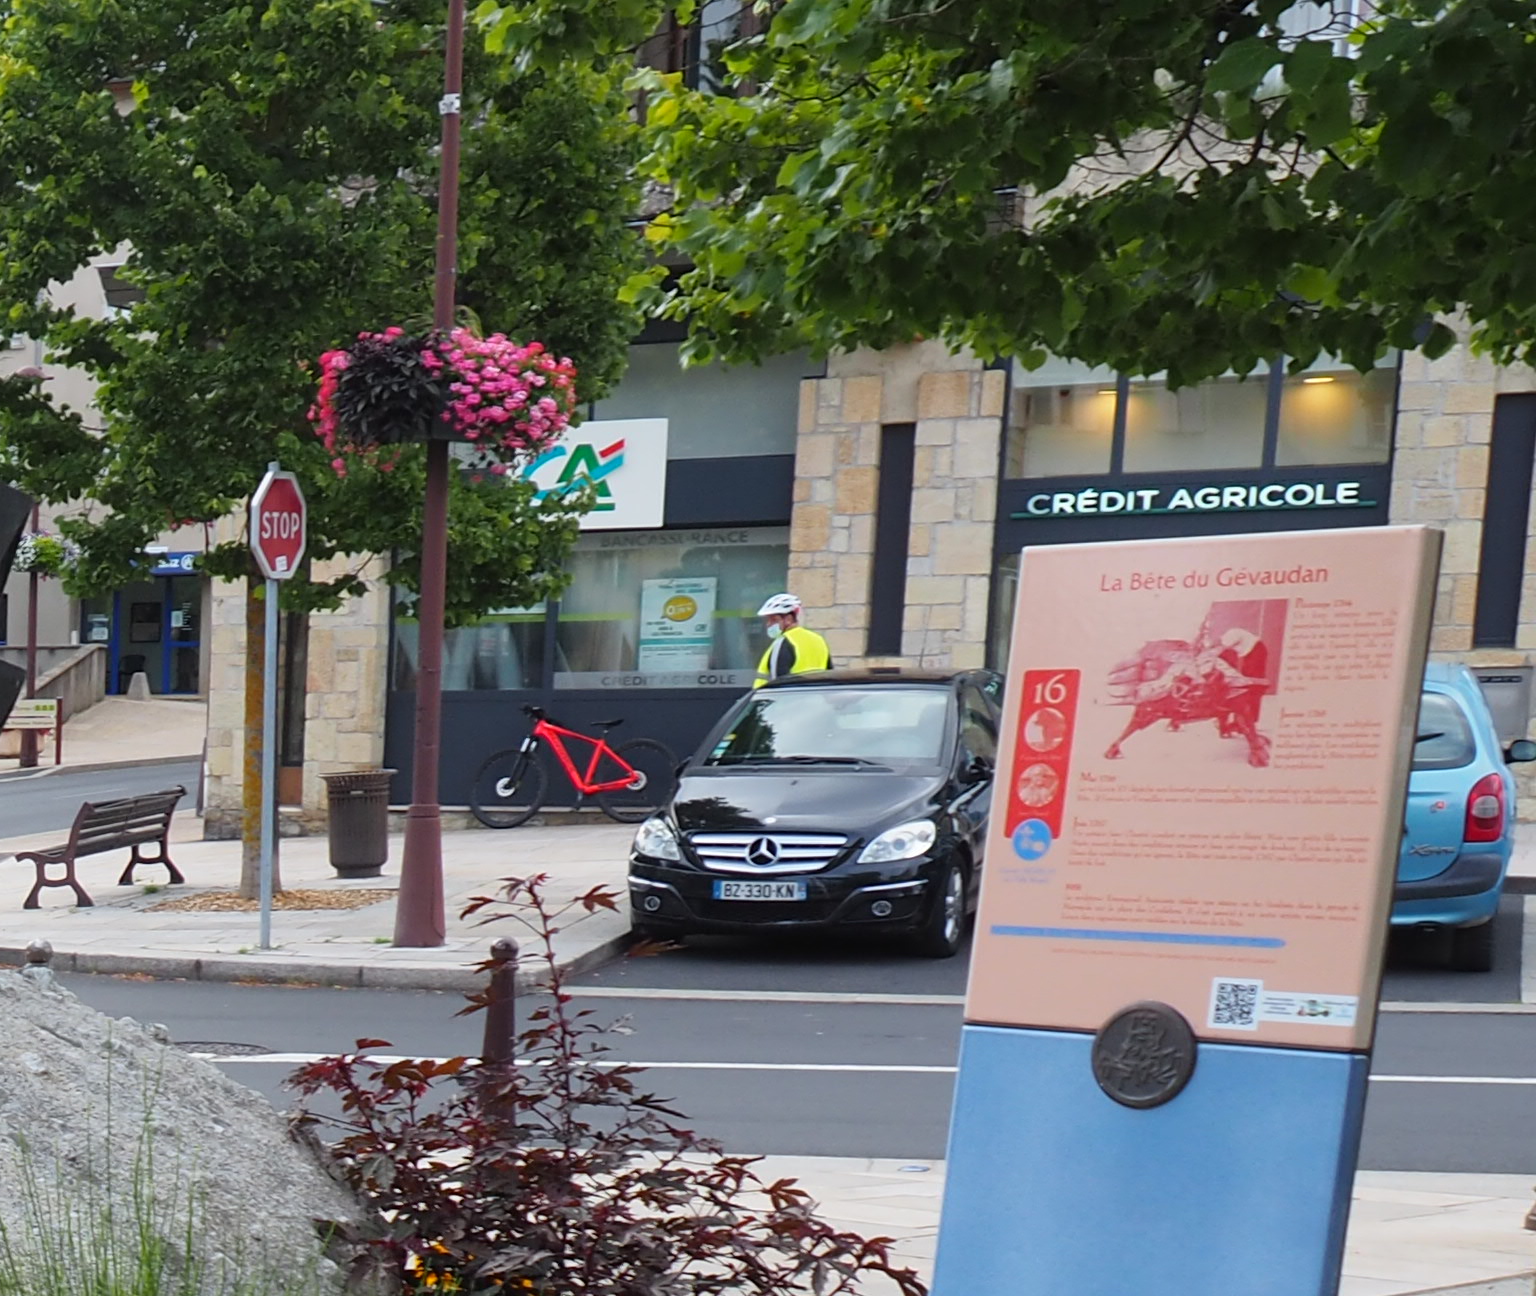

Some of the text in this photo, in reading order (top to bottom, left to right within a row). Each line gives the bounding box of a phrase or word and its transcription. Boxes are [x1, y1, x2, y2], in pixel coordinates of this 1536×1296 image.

[1027, 482, 1360, 515] CRÉDIT AGRICOLE
[261, 511, 300, 539] STOP
[1100, 565, 1328, 592] La Bête du Gévaudan
[1033, 672, 1067, 705] 16
[724, 883, 795, 898] BZ-330-KN
